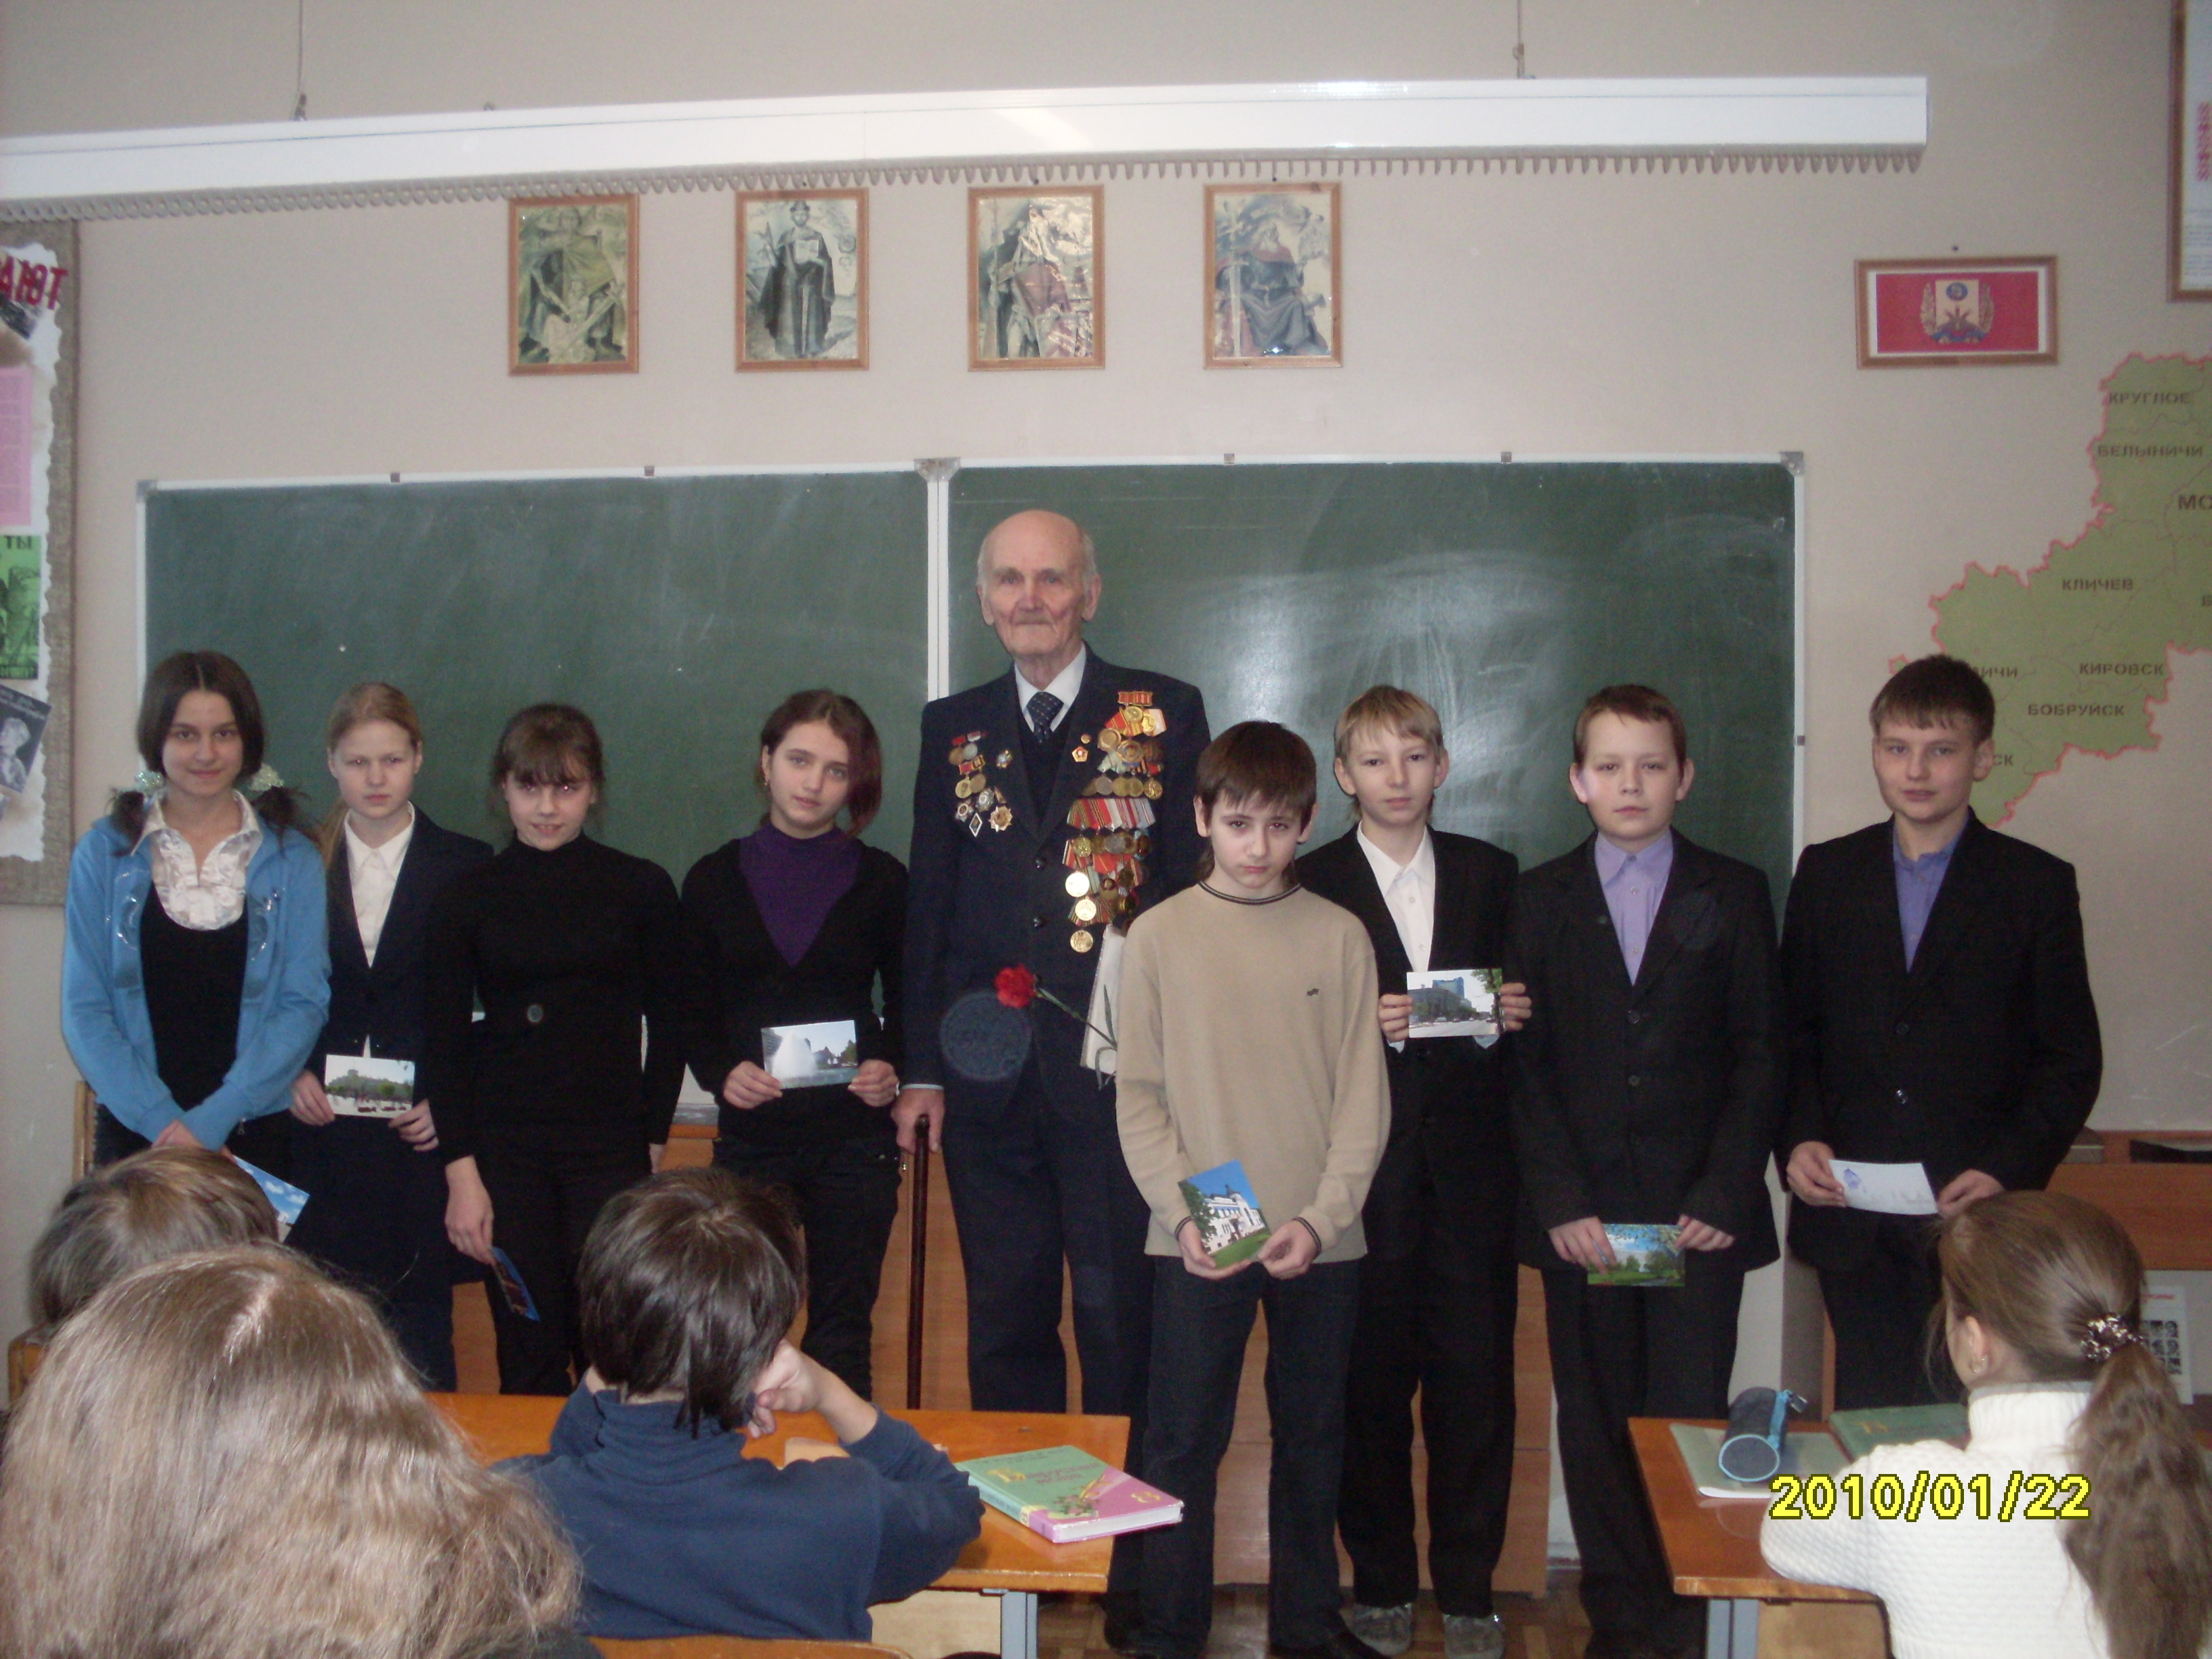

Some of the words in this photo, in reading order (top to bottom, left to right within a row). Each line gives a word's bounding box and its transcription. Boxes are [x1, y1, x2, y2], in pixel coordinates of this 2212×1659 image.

[2108, 392, 2191, 405] КРУГЛОЕ
[2097, 445, 2203, 457] БЕЛЫНИЧИ
[2062, 578, 2134, 591] КЛИЧЕВ
[2078, 662, 2165, 676] КИРОВСК
[2028, 702, 2125, 717] БОБРУЙСК
